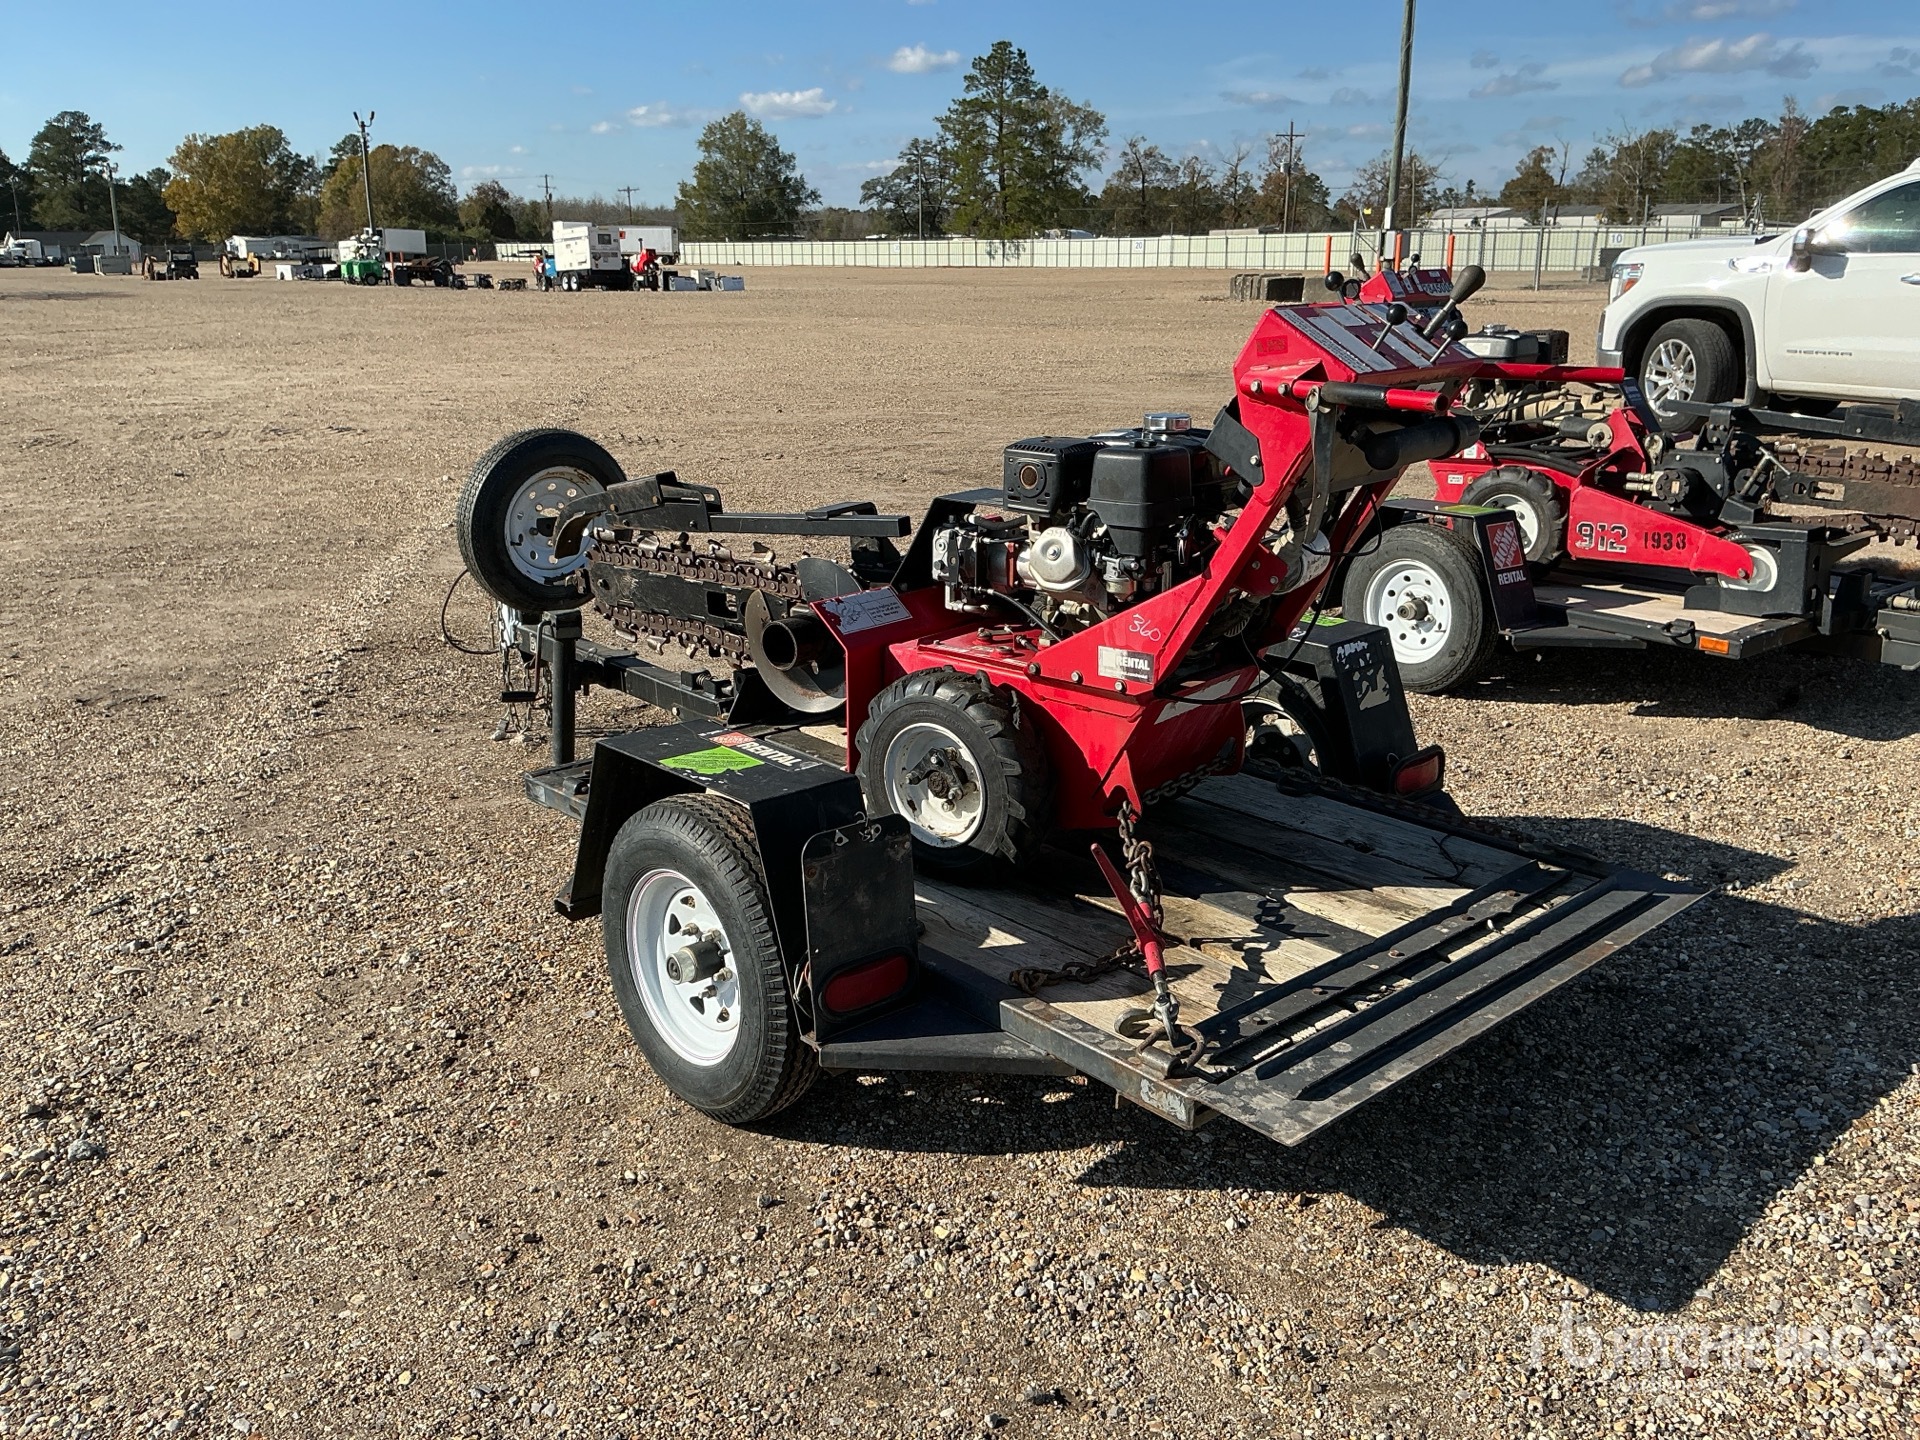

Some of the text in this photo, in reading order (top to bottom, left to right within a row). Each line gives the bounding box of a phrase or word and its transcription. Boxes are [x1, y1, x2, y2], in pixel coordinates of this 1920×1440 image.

[1135, 241, 1143, 250] 20
[1611, 233, 1623, 244] 10
[1786, 348, 1852, 357] SIERRA
[1575, 521, 1628, 554] 912
[1497, 569, 1527, 586] RENTAL
[1128, 613, 1162, 642] 360
[1115, 655, 1151, 671] RENTAL
[736, 741, 802, 767] RENTAL
